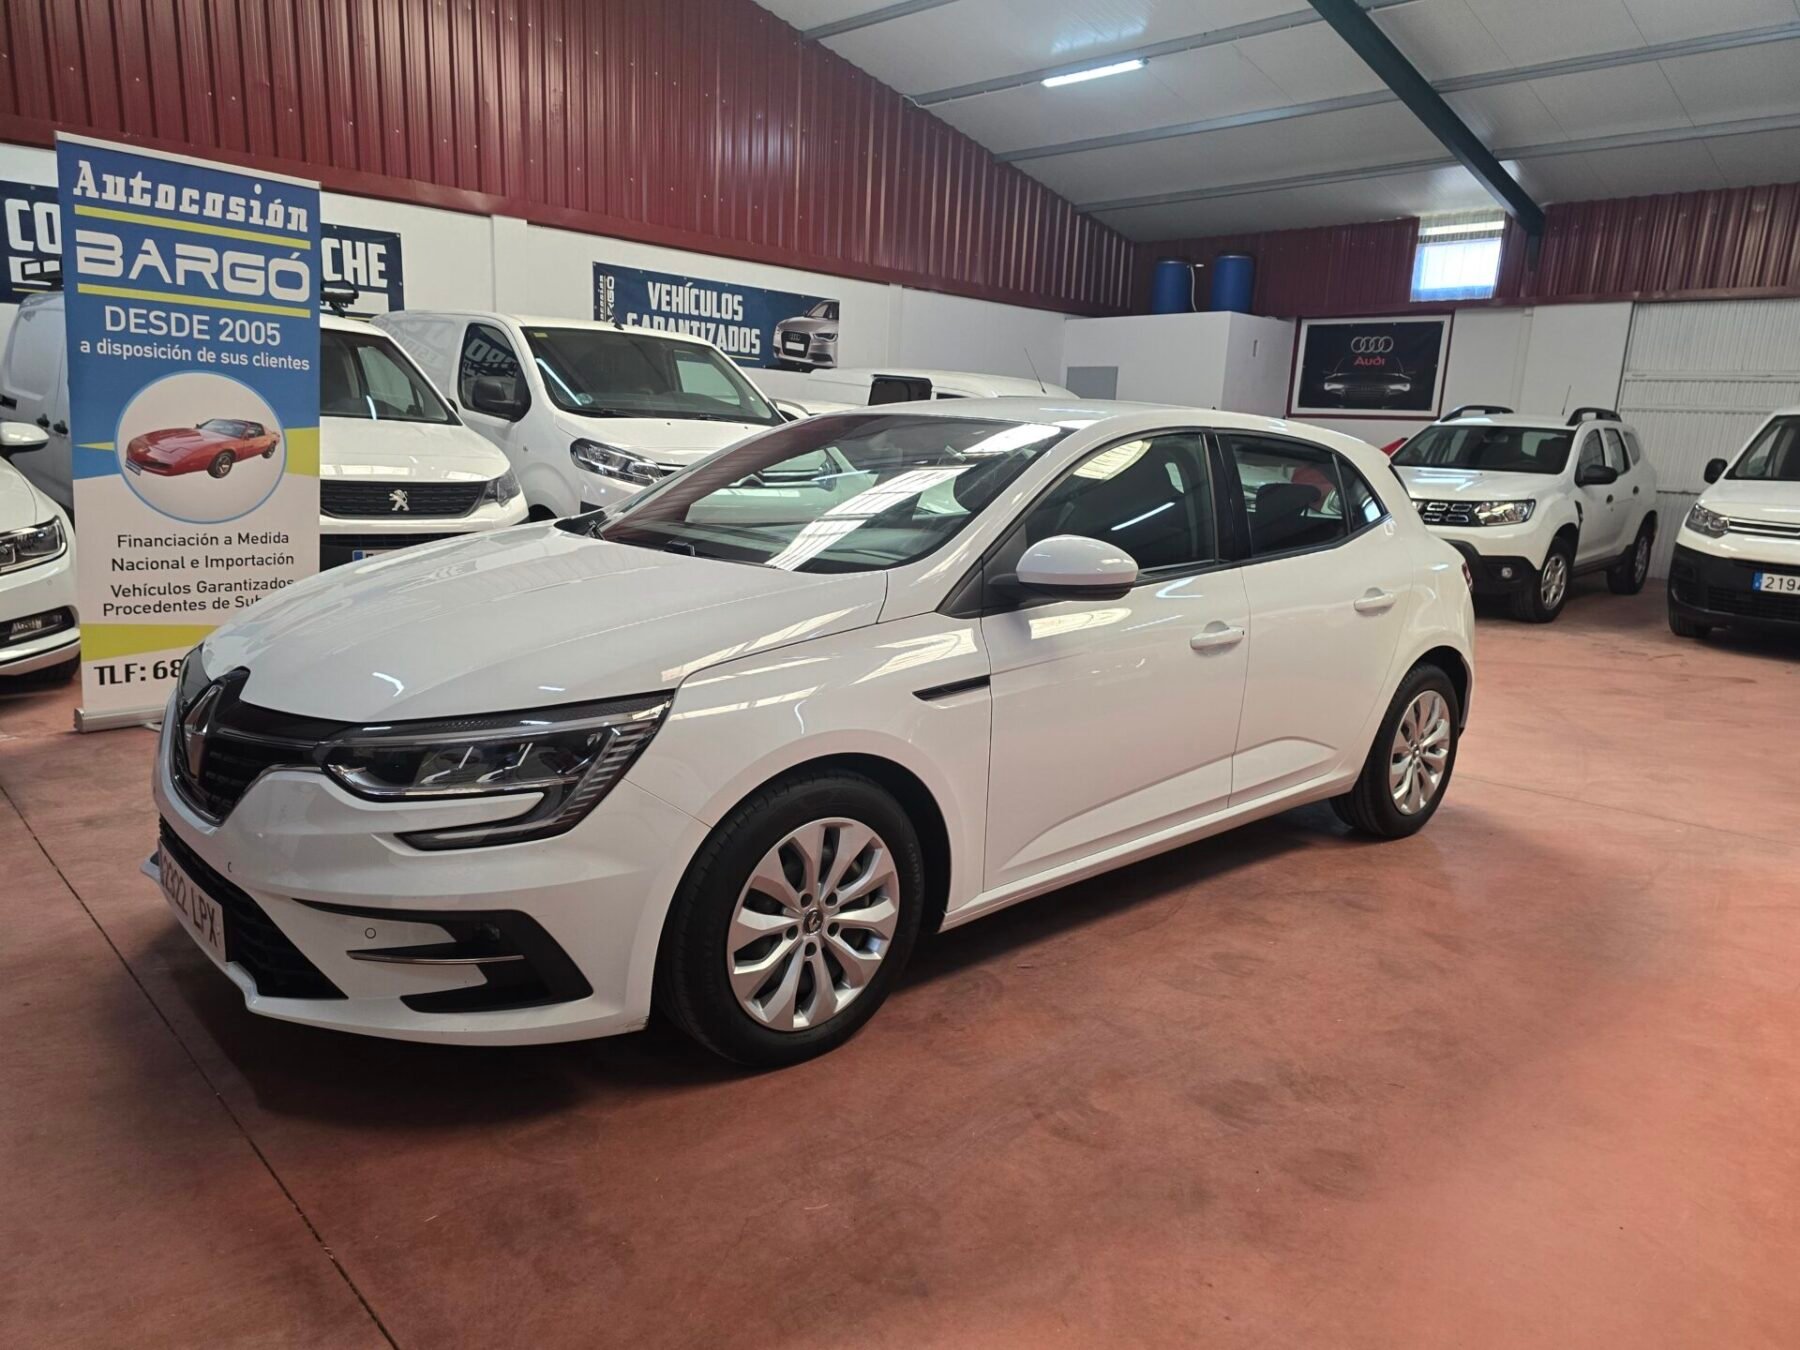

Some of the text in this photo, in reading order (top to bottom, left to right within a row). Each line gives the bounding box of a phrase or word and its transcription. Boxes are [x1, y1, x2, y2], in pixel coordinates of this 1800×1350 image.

[73, 160, 309, 233] Autocasión
[5, 198, 63, 255] CO
[75, 229, 311, 302] BARGÓ
[321, 237, 388, 289] CHE
[647, 281, 744, 322] VEHÍCULOS
[105, 305, 281, 346] DESDE 2005
[80, 338, 310, 371] a disposición de sus clientes
[1353, 355, 1386, 366] Audi
[117, 531, 289, 548] Financiación a Medida
[111, 552, 295, 572] Nacional e Importación
[110, 581, 192, 598] Vehículos
[1764, 576, 1800, 592] 219
[103, 599, 207, 617] Procedentes
[212, 597, 230, 610] de
[93, 659, 183, 686] TLF: 68
[190, 887, 218, 948] LPX
